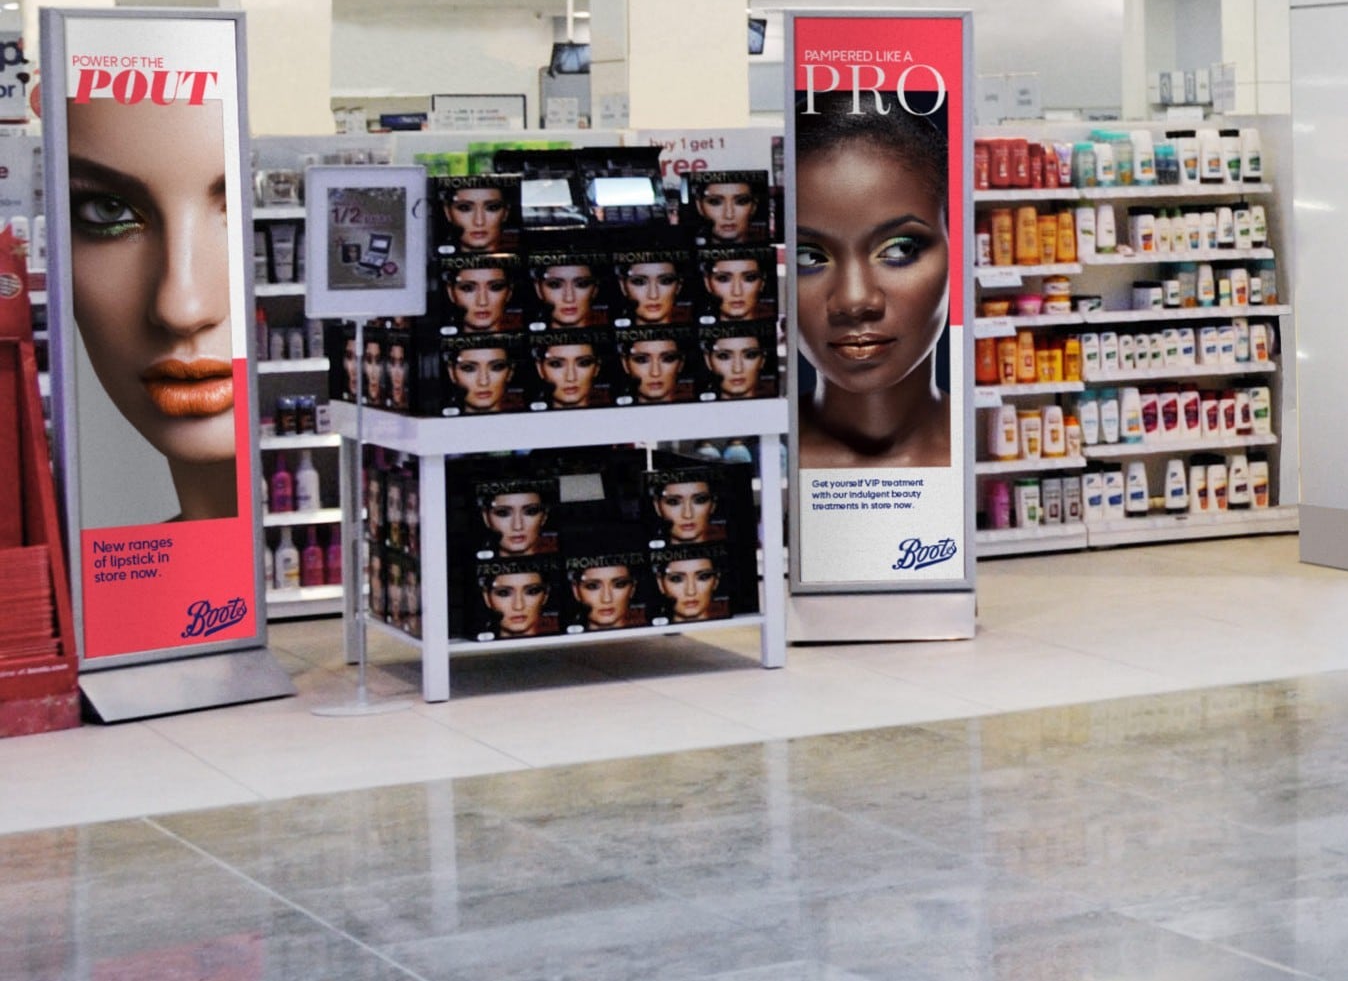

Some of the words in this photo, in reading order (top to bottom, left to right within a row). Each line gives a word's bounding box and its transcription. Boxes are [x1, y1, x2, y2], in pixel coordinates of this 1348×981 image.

[72, 55, 118, 67] POWER
[121, 56, 137, 68] OF
[141, 57, 164, 68] THE
[804, 50, 873, 62] PAMPERED
[876, 51, 901, 62] LIKE
[903, 51, 914, 62] A
[73, 68, 218, 106] POUT
[800, 64, 946, 116] PRO
[689, 137, 714, 152] get
[660, 158, 708, 177] ree
[812, 480, 828, 488] Get
[830, 479, 863, 489] yourself
[864, 479, 880, 487] VIP
[881, 479, 924, 487] treatment
[812, 491, 831, 499] with
[849, 490, 890, 500] indulgent
[892, 490, 921, 499] beauty
[812, 502, 859, 510] treatments
[871, 502, 892, 510] store
[93, 540, 125, 553] New
[128, 537, 173, 551] ranges
[94, 554, 107, 569] of
[110, 552, 154, 569] lipstick
[157, 552, 169, 563] in
[892, 538, 957, 570] Boots
[94, 570, 127, 583] store
[130, 568, 162, 580] now.
[181, 597, 247, 638] Boots
